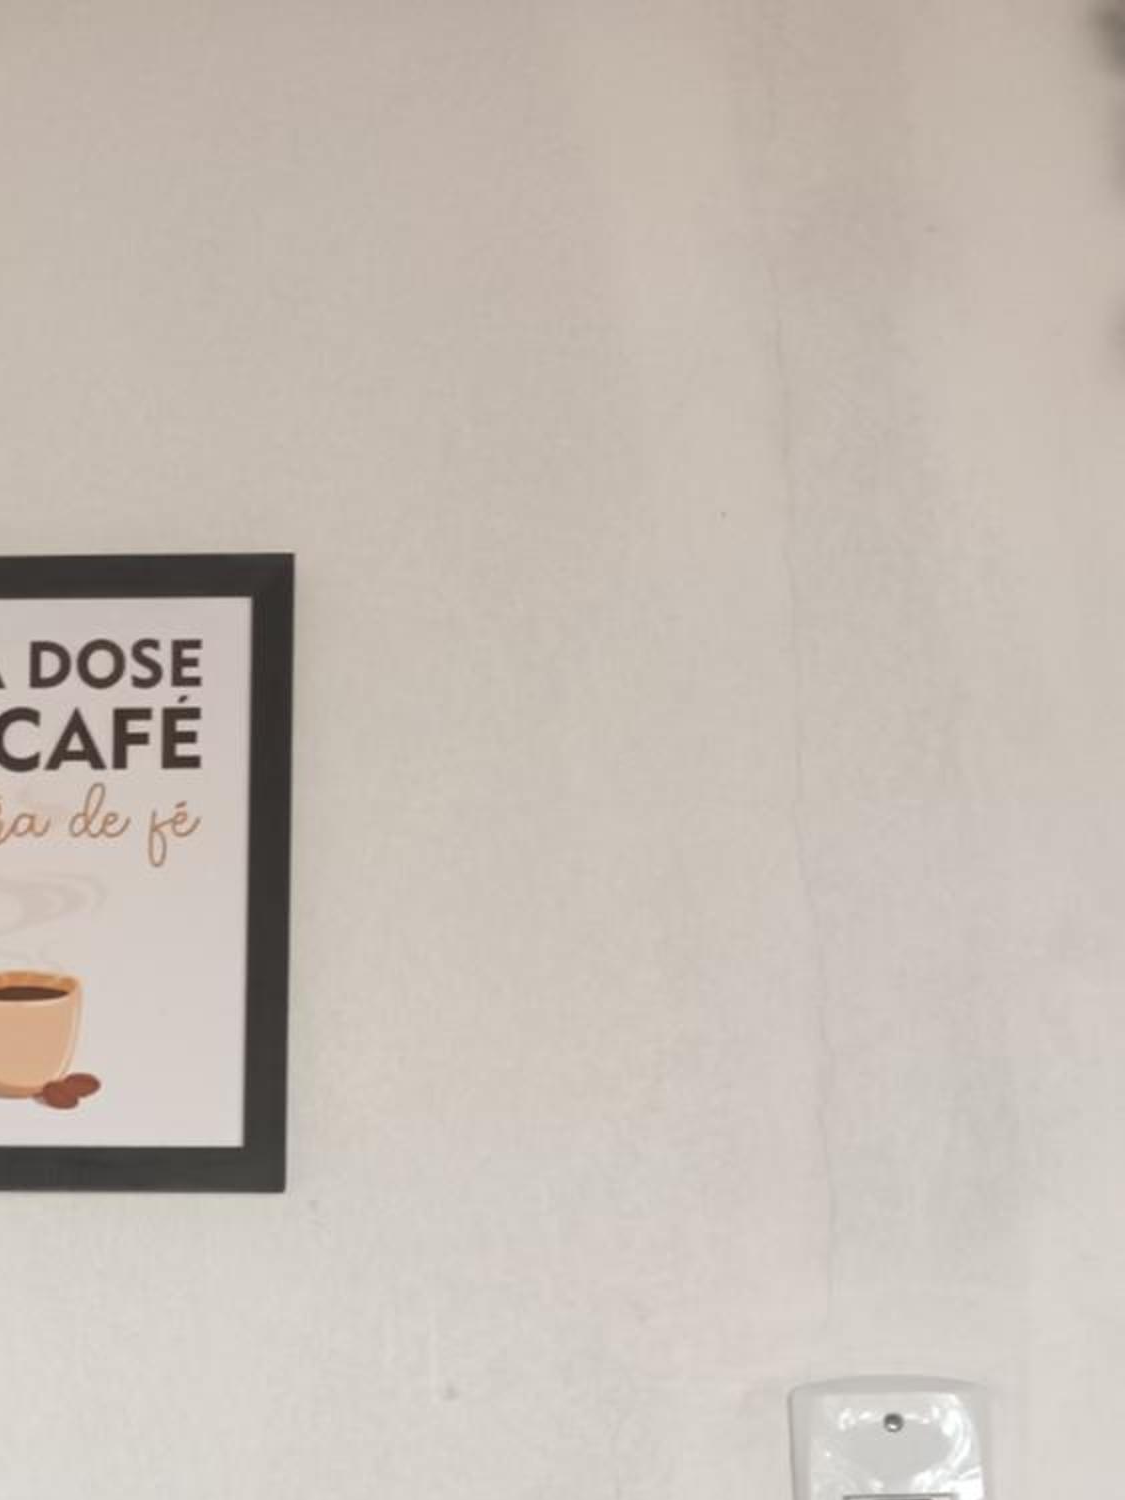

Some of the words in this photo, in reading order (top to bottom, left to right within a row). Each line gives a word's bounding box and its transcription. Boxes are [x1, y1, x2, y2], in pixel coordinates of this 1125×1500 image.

[29, 638, 203, 690] DOSE
[69, 782, 131, 839] de
[148, 801, 202, 868] fé
